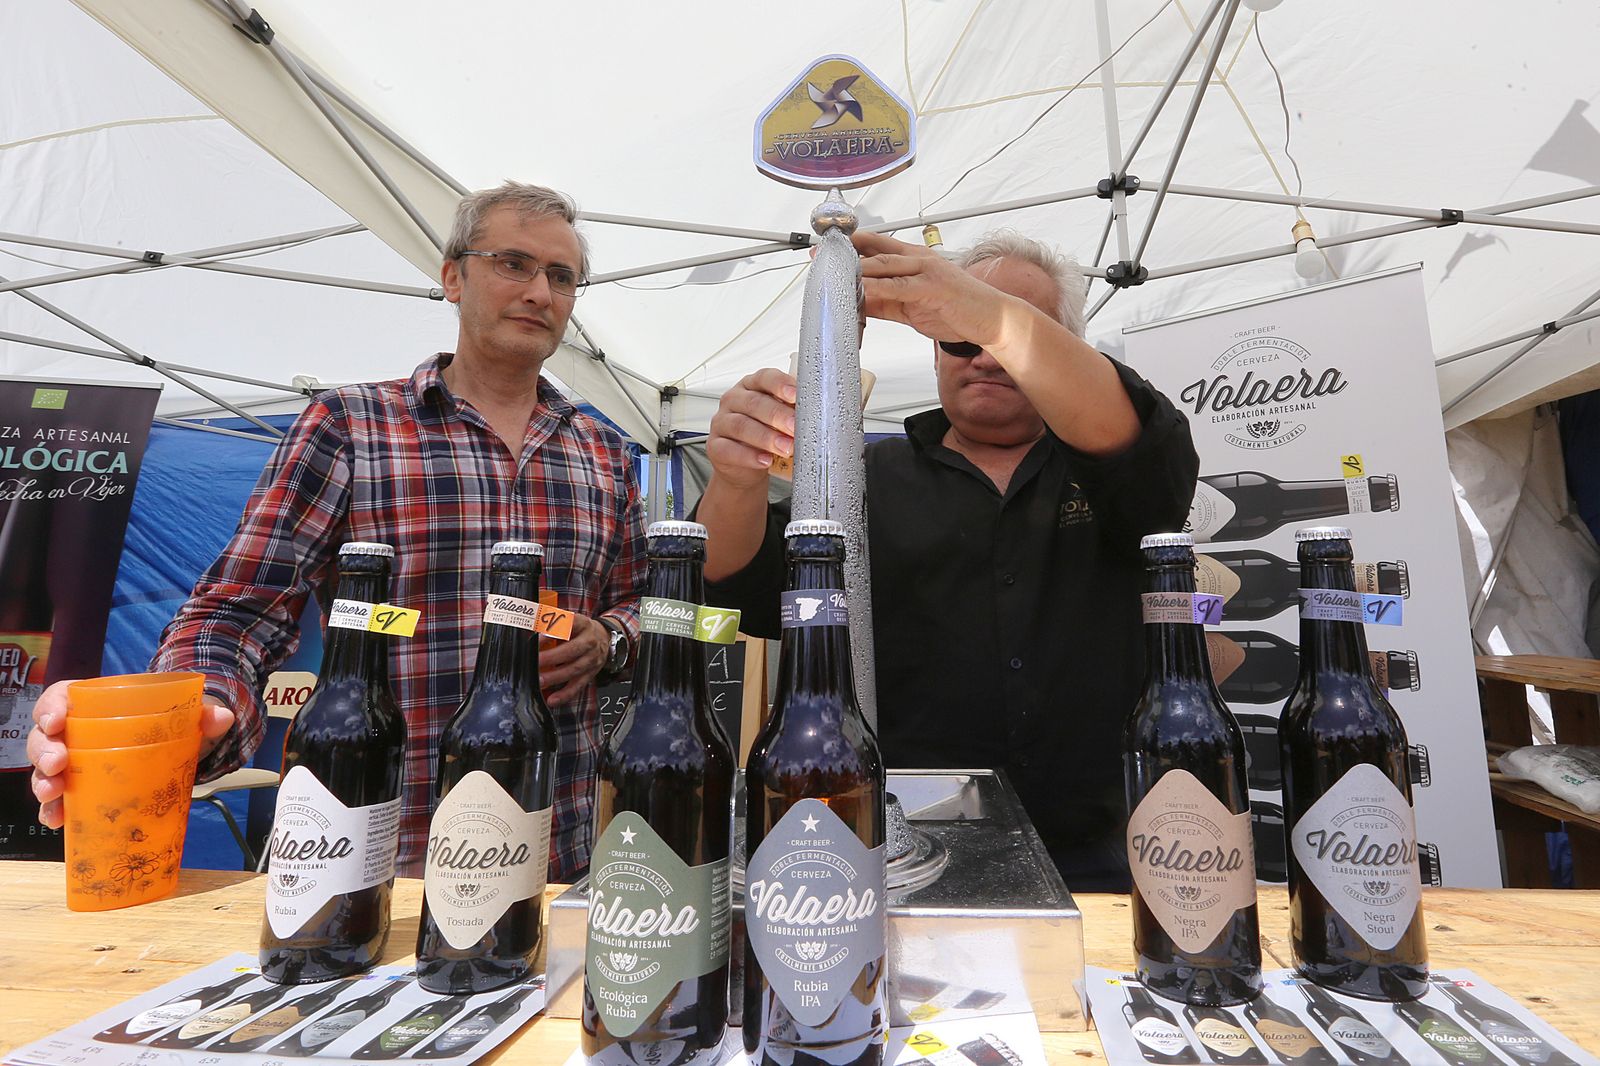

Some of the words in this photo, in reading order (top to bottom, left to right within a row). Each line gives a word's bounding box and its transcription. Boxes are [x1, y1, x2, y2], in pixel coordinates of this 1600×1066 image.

[773, 137, 895, 160] VOLAERA
[1234, 328, 1256, 339] CRAFT
[1257, 325, 1276, 334] BEER
[1213, 347, 1238, 371] DOBLE
[1241, 339, 1309, 361] FERMENTACIÓN
[1236, 353, 1280, 367] CERVEZA
[1180, 367, 1348, 415] Volaera
[1212, 408, 1265, 423] ELABORACIÓN
[1269, 402, 1316, 415] ARTESANAL
[33, 428, 131, 444] ARTESANAL
[1227, 435, 1269, 448] TOTALMENTE
[1273, 427, 1303, 446] NATURAL
[48, 487, 68, 499] en
[67, 475, 126, 501] Vejer
[492, 598, 535, 616] Volaera
[1146, 594, 1190, 608] Volaera
[1314, 593, 1361, 608] Volaera
[645, 600, 695, 621] Volaera
[1332, 809, 1353, 827] DOBLE
[1166, 827, 1202, 835] CERVEZA
[1353, 822, 1389, 830] CERVEZA
[791, 839, 811, 847] CRAFT
[812, 839, 831, 847] BEER
[1306, 828, 1417, 866] Volaera
[428, 832, 530, 870] Volaera
[611, 850, 628, 859] CRAFT
[628, 851, 646, 860] BEER
[1132, 833, 1244, 872] Volaera
[771, 855, 794, 877] DOBLE
[796, 852, 856, 881] FERMENTACIÓN
[1331, 865, 1379, 877] ELABORACIÓN
[473, 870, 510, 880] ARTESANAL
[614, 864, 671, 897] FERMENTACIÓN
[790, 870, 832, 879] CERVEZA
[1149, 868, 1190, 882] ELABORACIÓN
[1192, 873, 1228, 883] ARTESANAL
[609, 880, 646, 892] CERVEZA
[749, 879, 877, 926] Volaera
[274, 905, 297, 916] Rubia
[446, 916, 484, 927] Tostada
[1173, 914, 1207, 929] Negra
[1363, 911, 1396, 925] Negra
[766, 923, 814, 936] ELABORACIÓN
[817, 923, 858, 936] ARTESANAL
[1181, 927, 1200, 939] IPA
[1367, 923, 1395, 934] Stout
[628, 937, 672, 949] ARTESANAL
[818, 950, 847, 972] NATURAL
[794, 980, 829, 993] Rubia
[599, 986, 648, 1006] Ecológica
[801, 995, 821, 1007] IPA
[605, 1004, 637, 1019] Rubia
[1135, 1029, 1185, 1039] Volaera
[1197, 1030, 1248, 1040] Volaera
